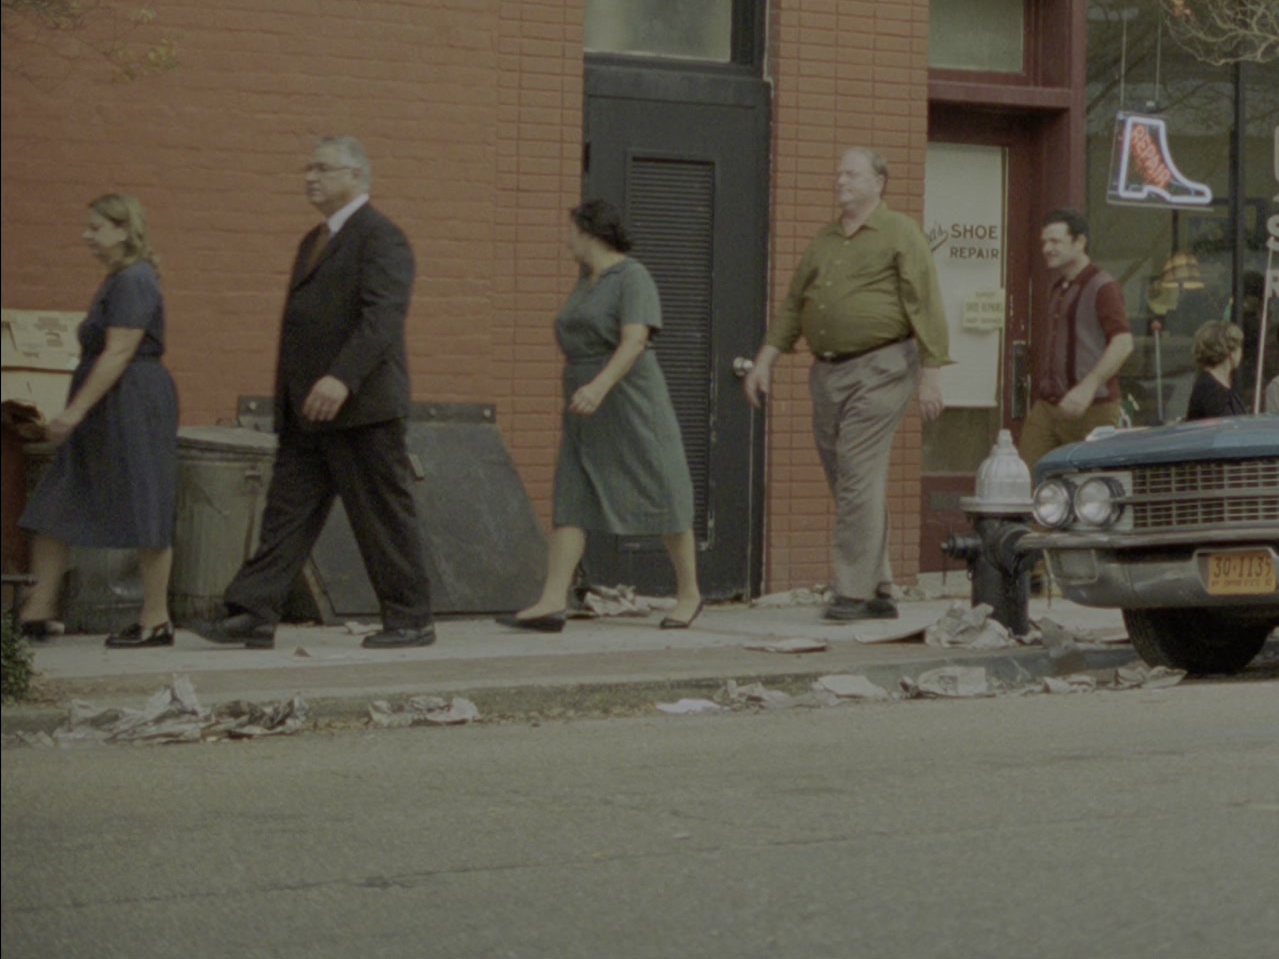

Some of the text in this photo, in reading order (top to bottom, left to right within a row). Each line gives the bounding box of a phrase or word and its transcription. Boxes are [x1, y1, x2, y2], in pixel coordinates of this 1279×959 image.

[1131, 125, 1171, 189] REPAIR
[951, 223, 998, 240] SHOE
[950, 246, 1000, 259] REPAIR
